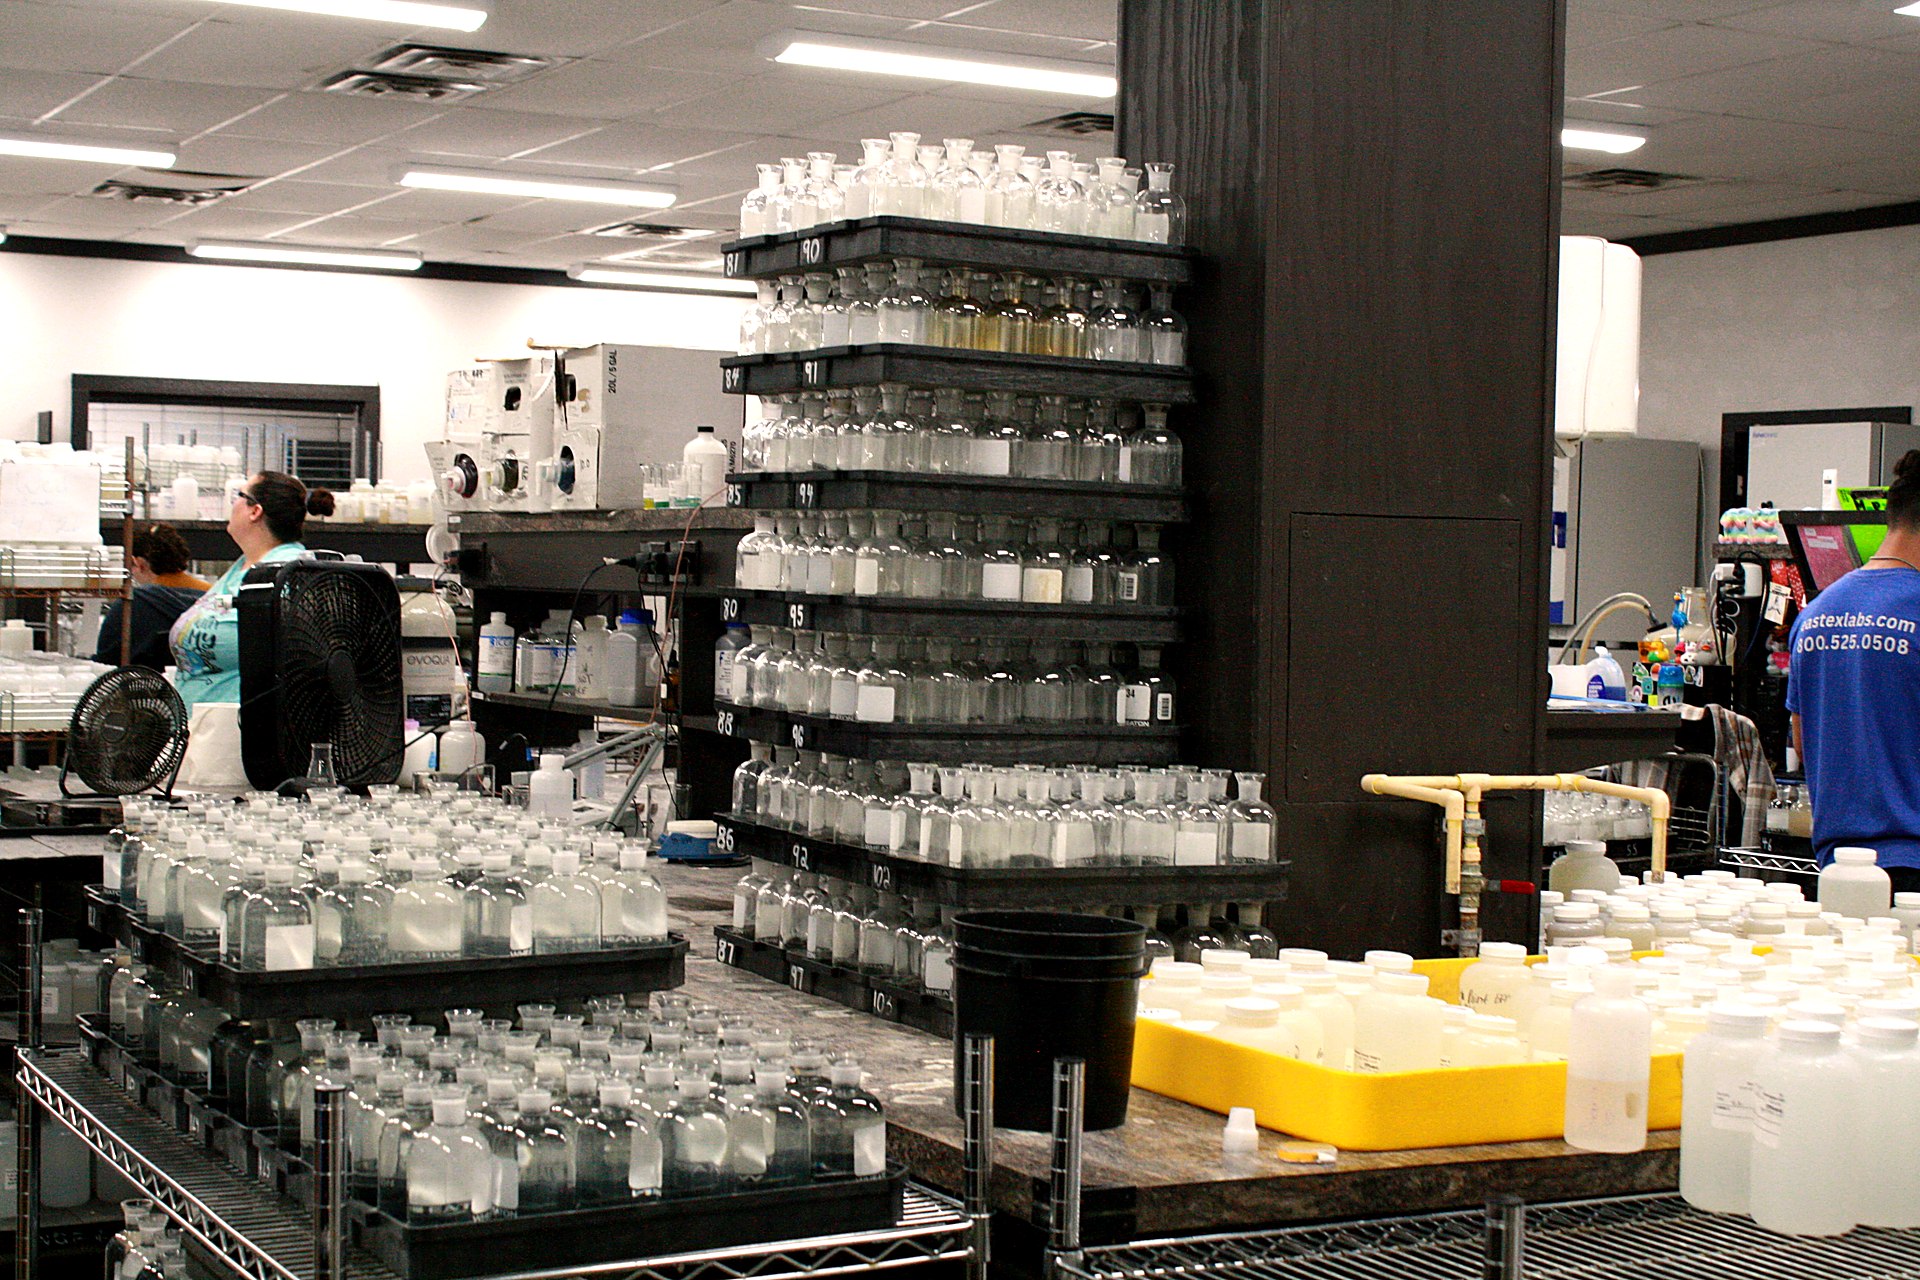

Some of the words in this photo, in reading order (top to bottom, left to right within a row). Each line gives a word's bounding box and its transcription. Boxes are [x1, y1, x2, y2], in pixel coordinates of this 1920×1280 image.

[803, 238, 820, 264] 90
[726, 253, 739, 277] 81
[725, 367, 739, 390] 84
[805, 361, 817, 384] 91
[727, 484, 742, 506] 85
[799, 483, 814, 508] 94
[723, 598, 738, 621] 80
[790, 604, 804, 628] 95
[1797, 634, 1910, 655] 800.525.0508
[717, 711, 734, 736] 88
[792, 724, 804, 748] 96
[716, 825, 734, 851] 86
[792, 844, 809, 871] 92
[873, 863, 891, 889] 102
[717, 939, 734, 965] 87
[789, 966, 804, 991] 97
